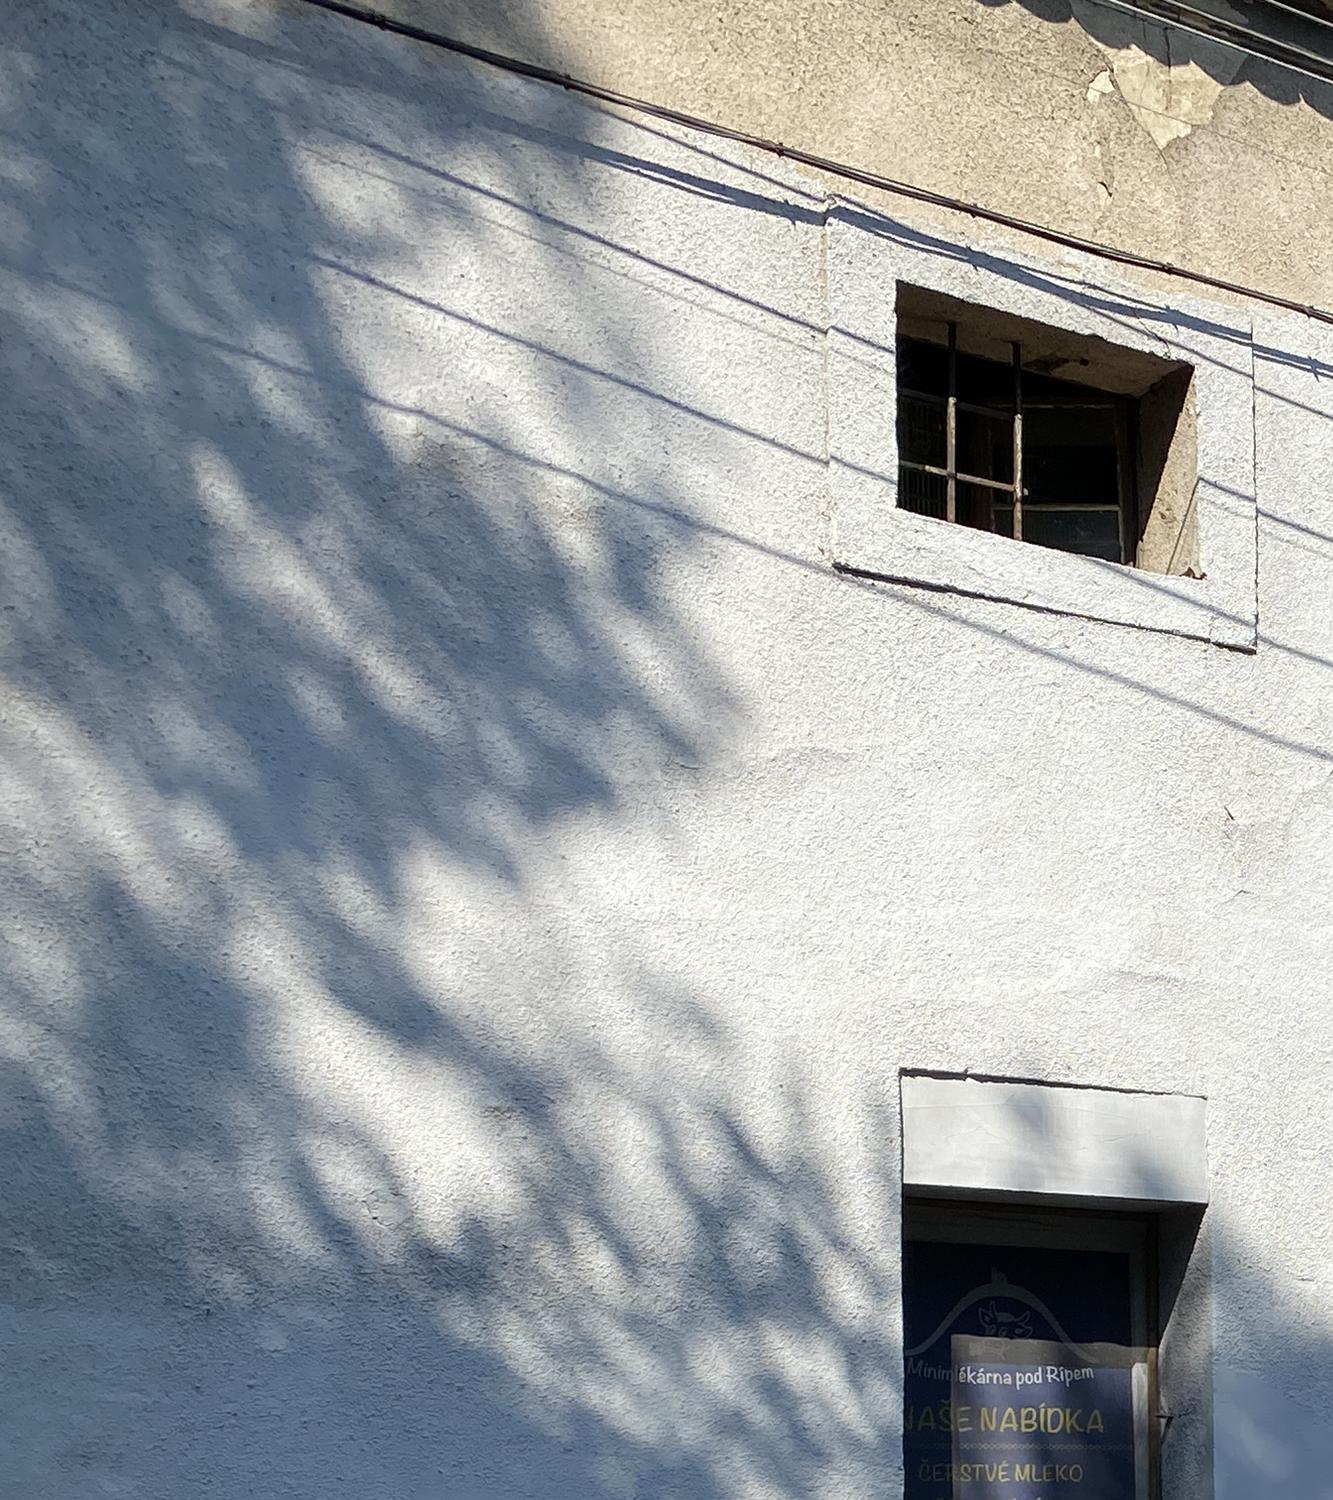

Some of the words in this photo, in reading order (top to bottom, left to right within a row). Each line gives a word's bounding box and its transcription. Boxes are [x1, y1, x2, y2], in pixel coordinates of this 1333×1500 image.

[907, 1356, 1012, 1385] Minimlékárna
[1015, 1366, 1043, 1390] pod
[980, 1402, 1105, 1433] NABÍDKA
[919, 1459, 1009, 1483] ČERSTVÉ
[1014, 1460, 1083, 1483] MLÉKO
